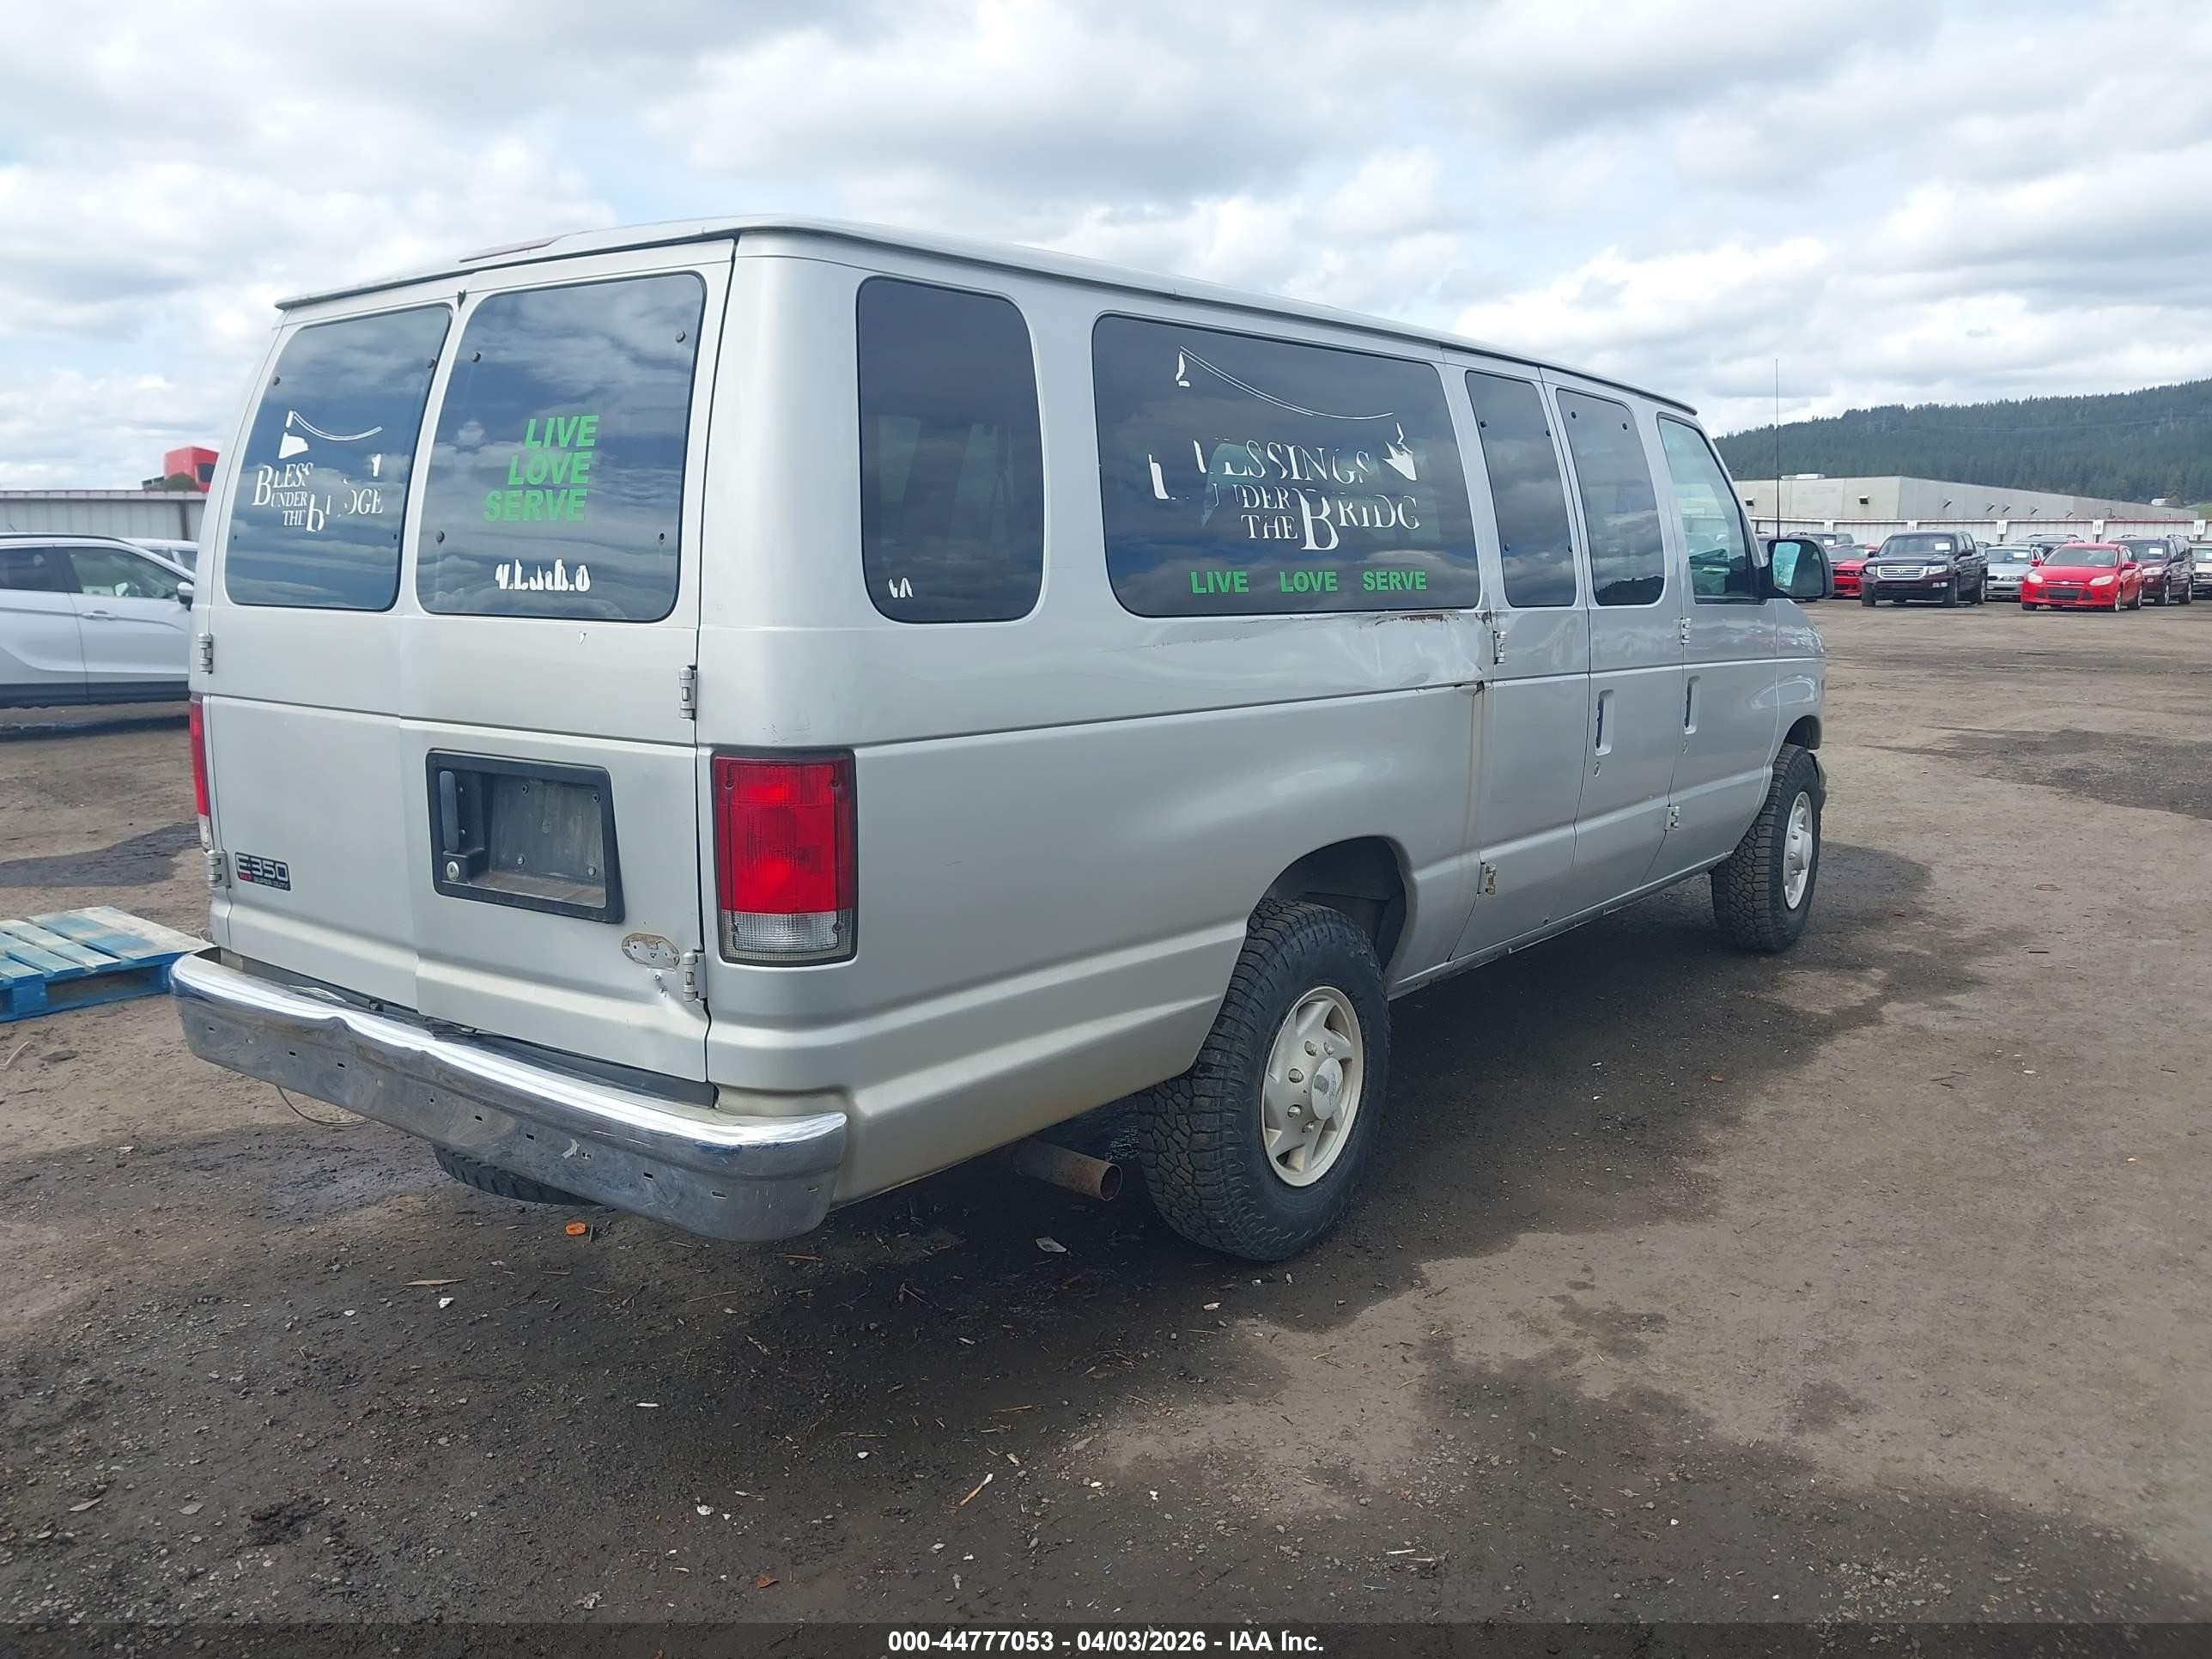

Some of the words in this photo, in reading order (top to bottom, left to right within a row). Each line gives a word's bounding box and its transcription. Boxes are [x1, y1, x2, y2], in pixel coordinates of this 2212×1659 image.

[525, 415, 599, 448] LIVE
[507, 451, 592, 486] LOVE
[483, 488, 587, 522] SERVE
[1241, 514, 1299, 540] THE
[1190, 570, 1250, 593] LIVE
[1279, 570, 1338, 592] LOVE
[1362, 570, 1427, 591] SERVE
